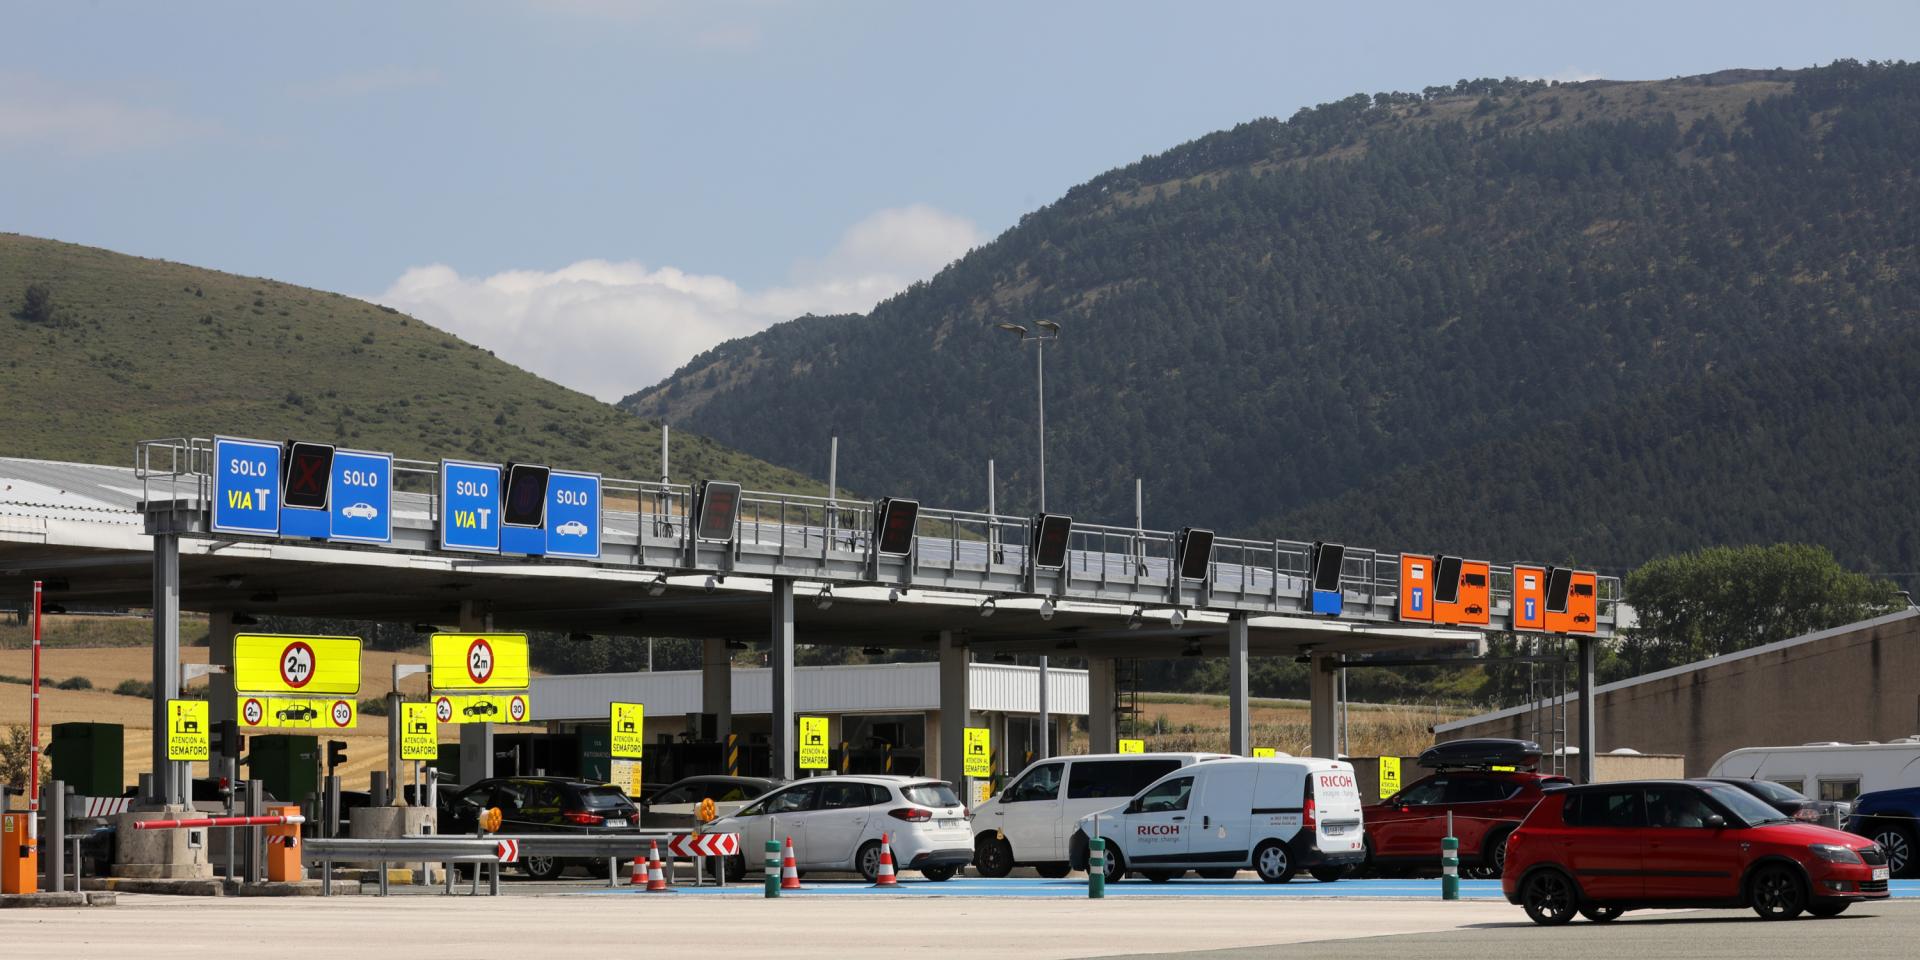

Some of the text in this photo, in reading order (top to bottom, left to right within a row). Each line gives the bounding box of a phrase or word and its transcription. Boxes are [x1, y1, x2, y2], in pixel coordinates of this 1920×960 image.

[231, 459, 266, 476] SOLO
[343, 471, 377, 487] SOLO
[457, 481, 488, 497] SOLO
[228, 490, 252, 510] VIA
[557, 490, 587, 506] SOLO
[455, 510, 476, 529] VIA
[287, 656, 307, 674] 2m
[473, 653, 488, 669] 2m
[247, 706, 258, 717] 2m
[335, 709, 348, 719] 30
[438, 704, 450, 715] 2m
[513, 704, 523, 714] 30
[170, 746, 207, 756] SEMAFORO
[403, 746, 436, 755] SEMAFORO
[612, 744, 641, 753] SEMAFORO
[801, 756, 828, 765] SEMAFORO
[1320, 776, 1353, 788] RICOH
[1137, 825, 1180, 835] RICOH
